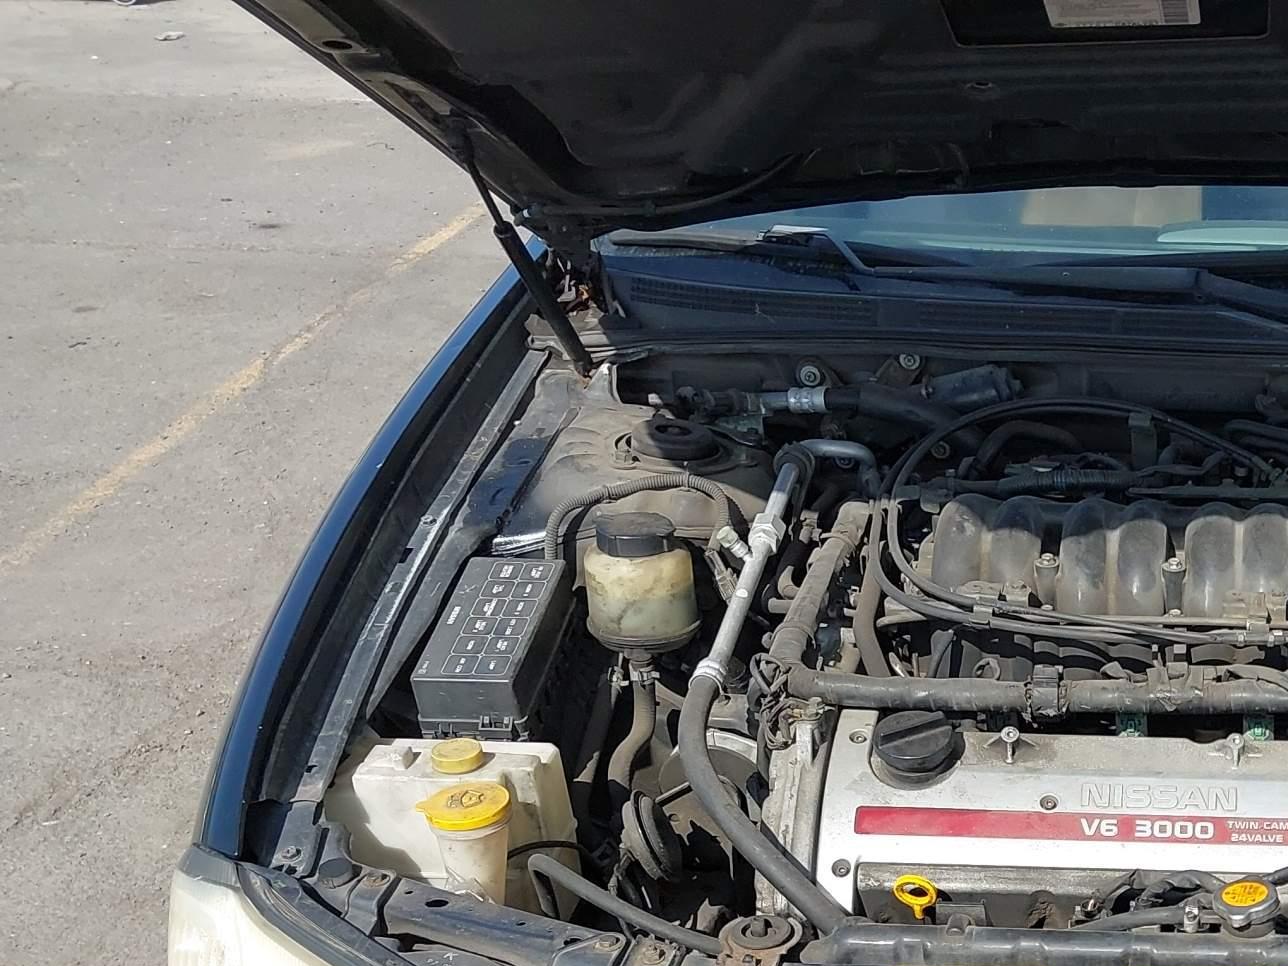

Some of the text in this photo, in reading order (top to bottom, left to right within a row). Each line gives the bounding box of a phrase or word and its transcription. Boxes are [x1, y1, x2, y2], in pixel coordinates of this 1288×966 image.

[1081, 783, 1238, 811] NISSAN
[1080, 818, 1215, 839] V6 3000
[1227, 821, 1258, 830] TWIN
[1231, 833, 1284, 843] 24VALVE
